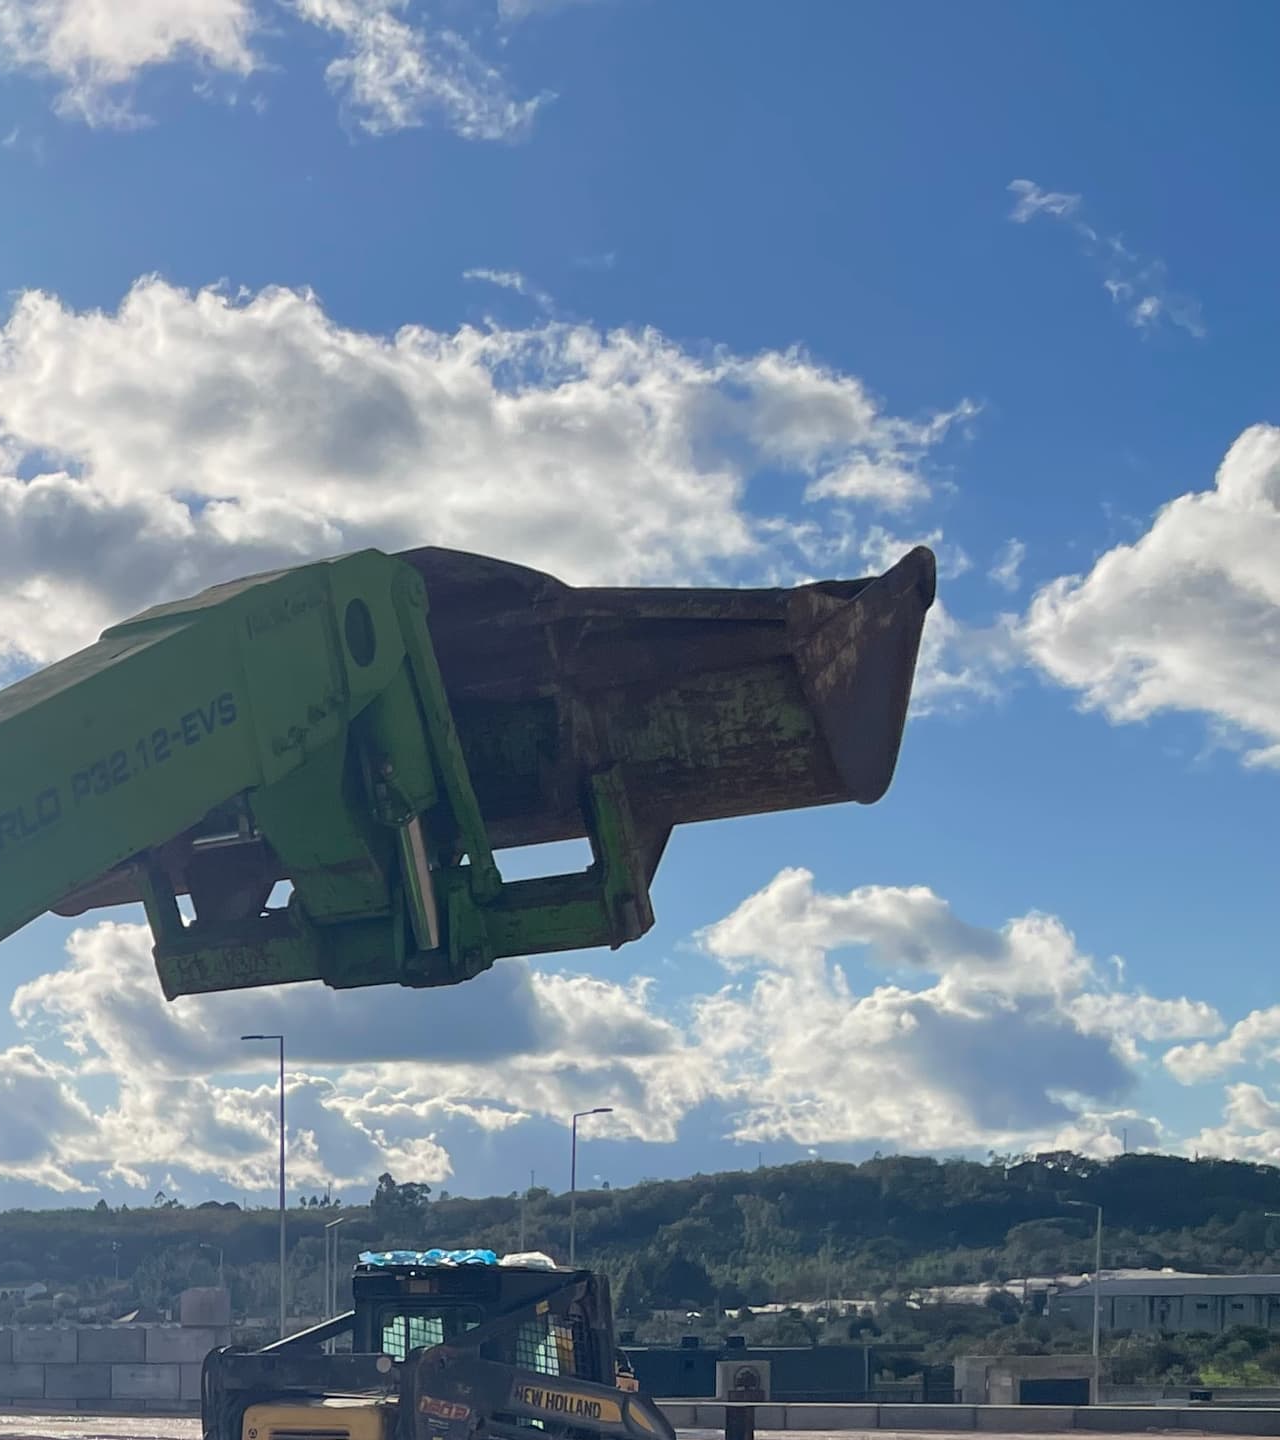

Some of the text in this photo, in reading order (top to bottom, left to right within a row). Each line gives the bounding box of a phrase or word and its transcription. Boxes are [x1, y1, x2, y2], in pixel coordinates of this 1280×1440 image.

[70, 691, 238, 807] P32.12-EVS
[515, 1384, 601, 1419] NEW HOLLAND
